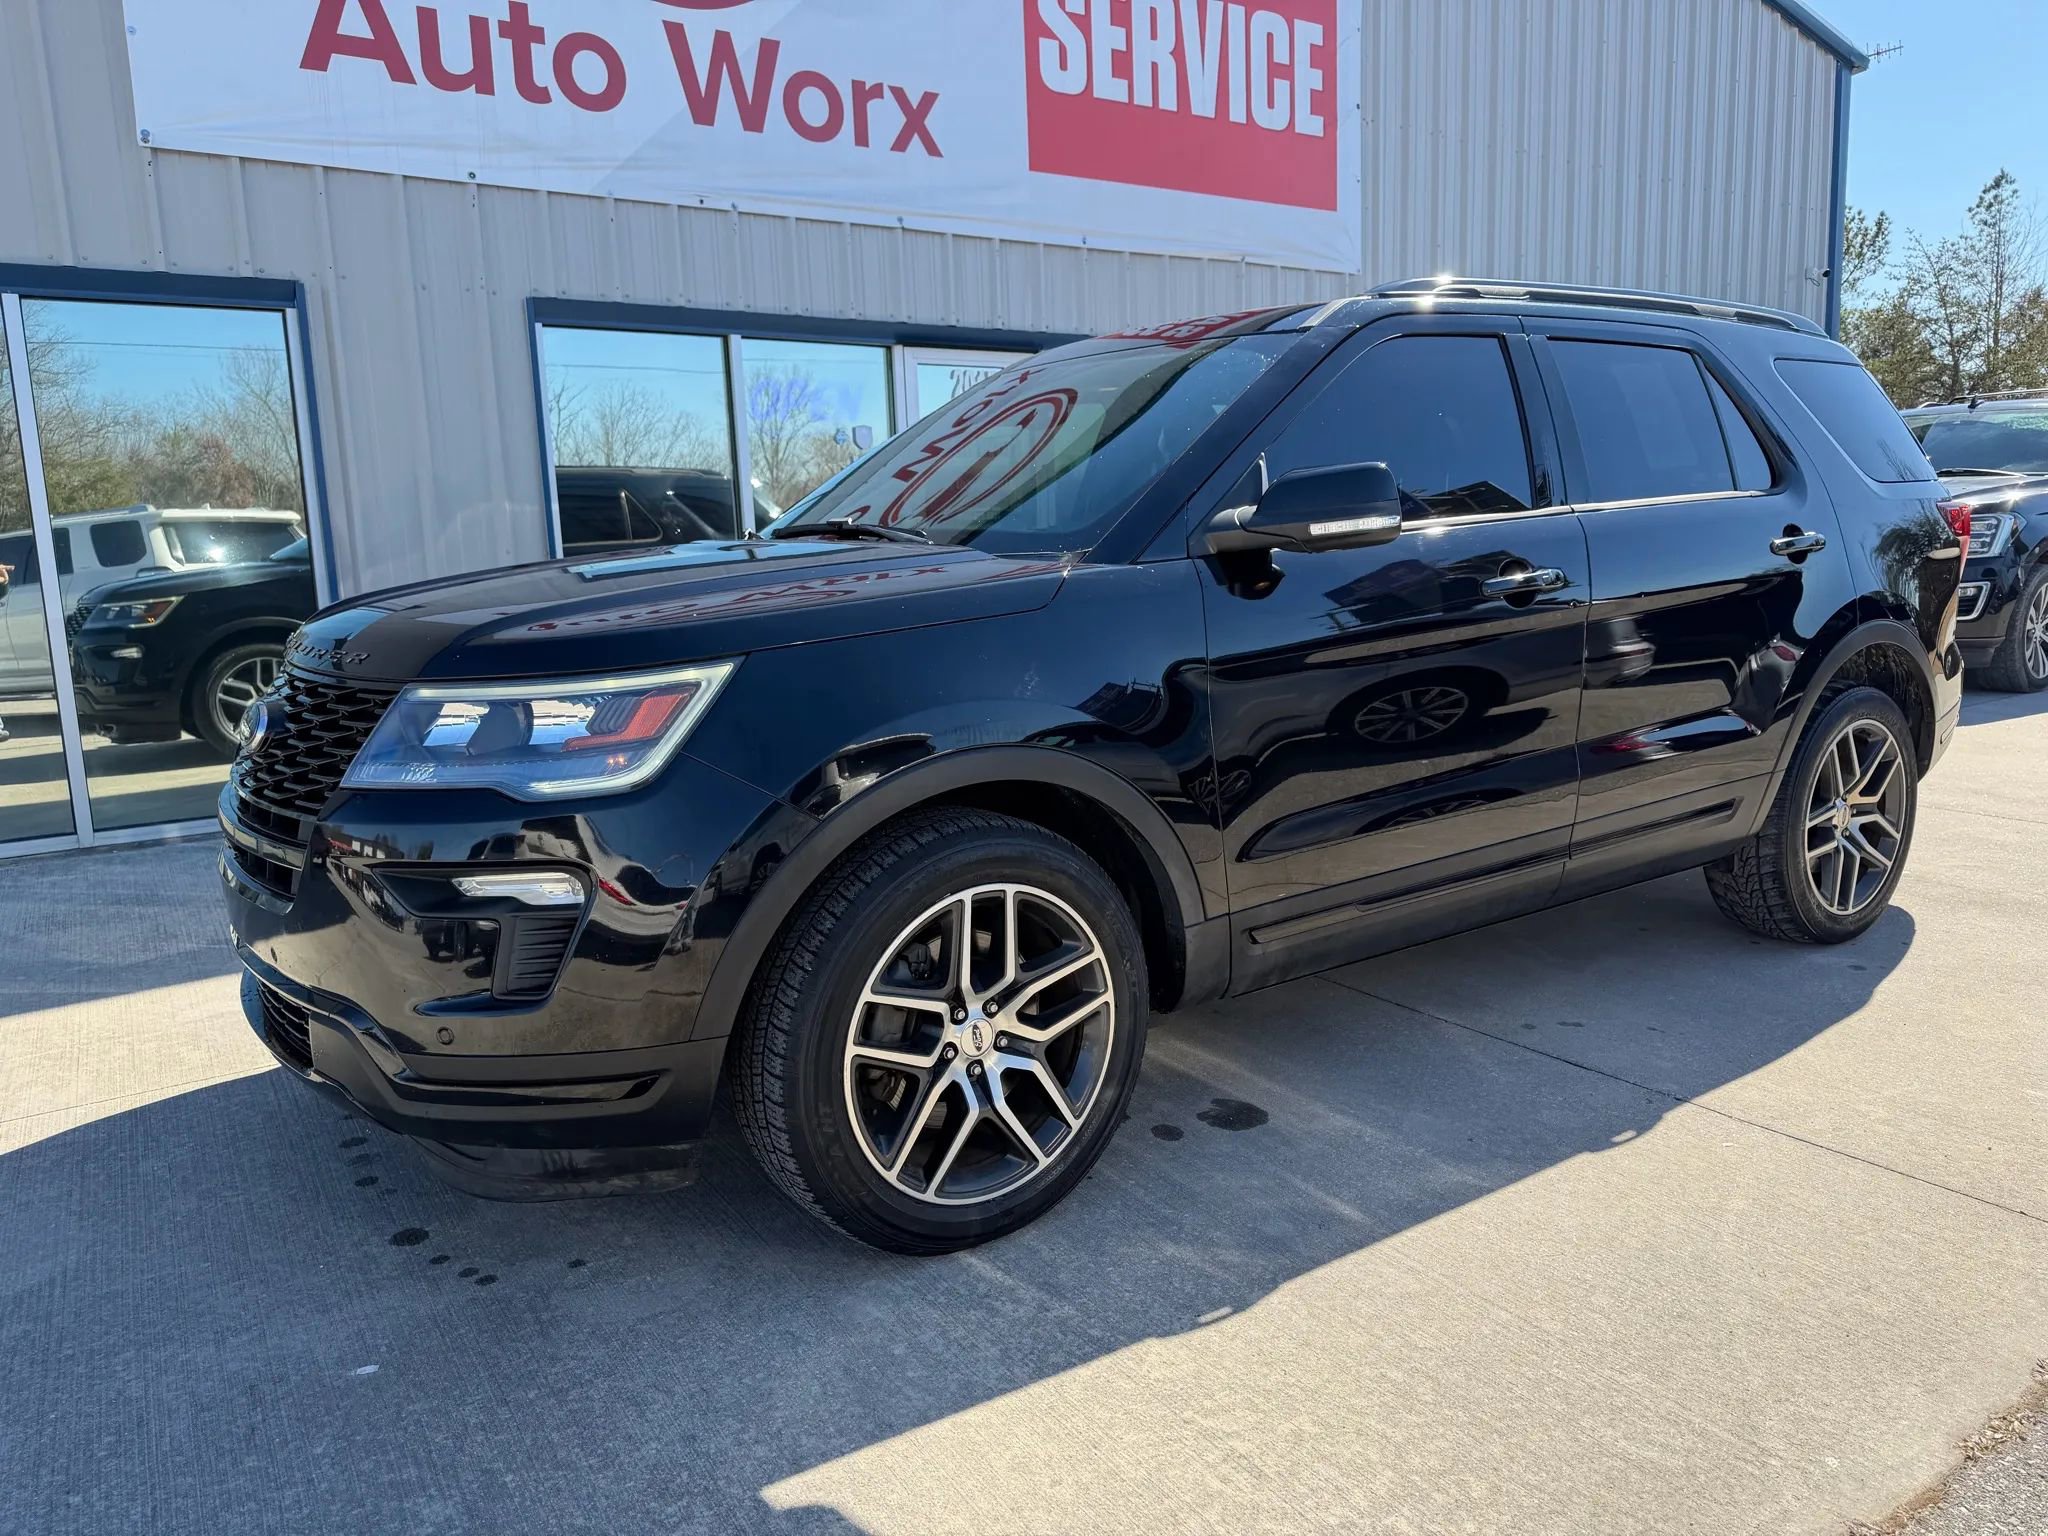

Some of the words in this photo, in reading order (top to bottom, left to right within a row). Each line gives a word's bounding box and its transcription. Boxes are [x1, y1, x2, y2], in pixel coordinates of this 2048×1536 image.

[299, 0, 627, 113] Auto
[661, 19, 944, 159] Worx
[1037, 0, 1325, 137] SERVICE
